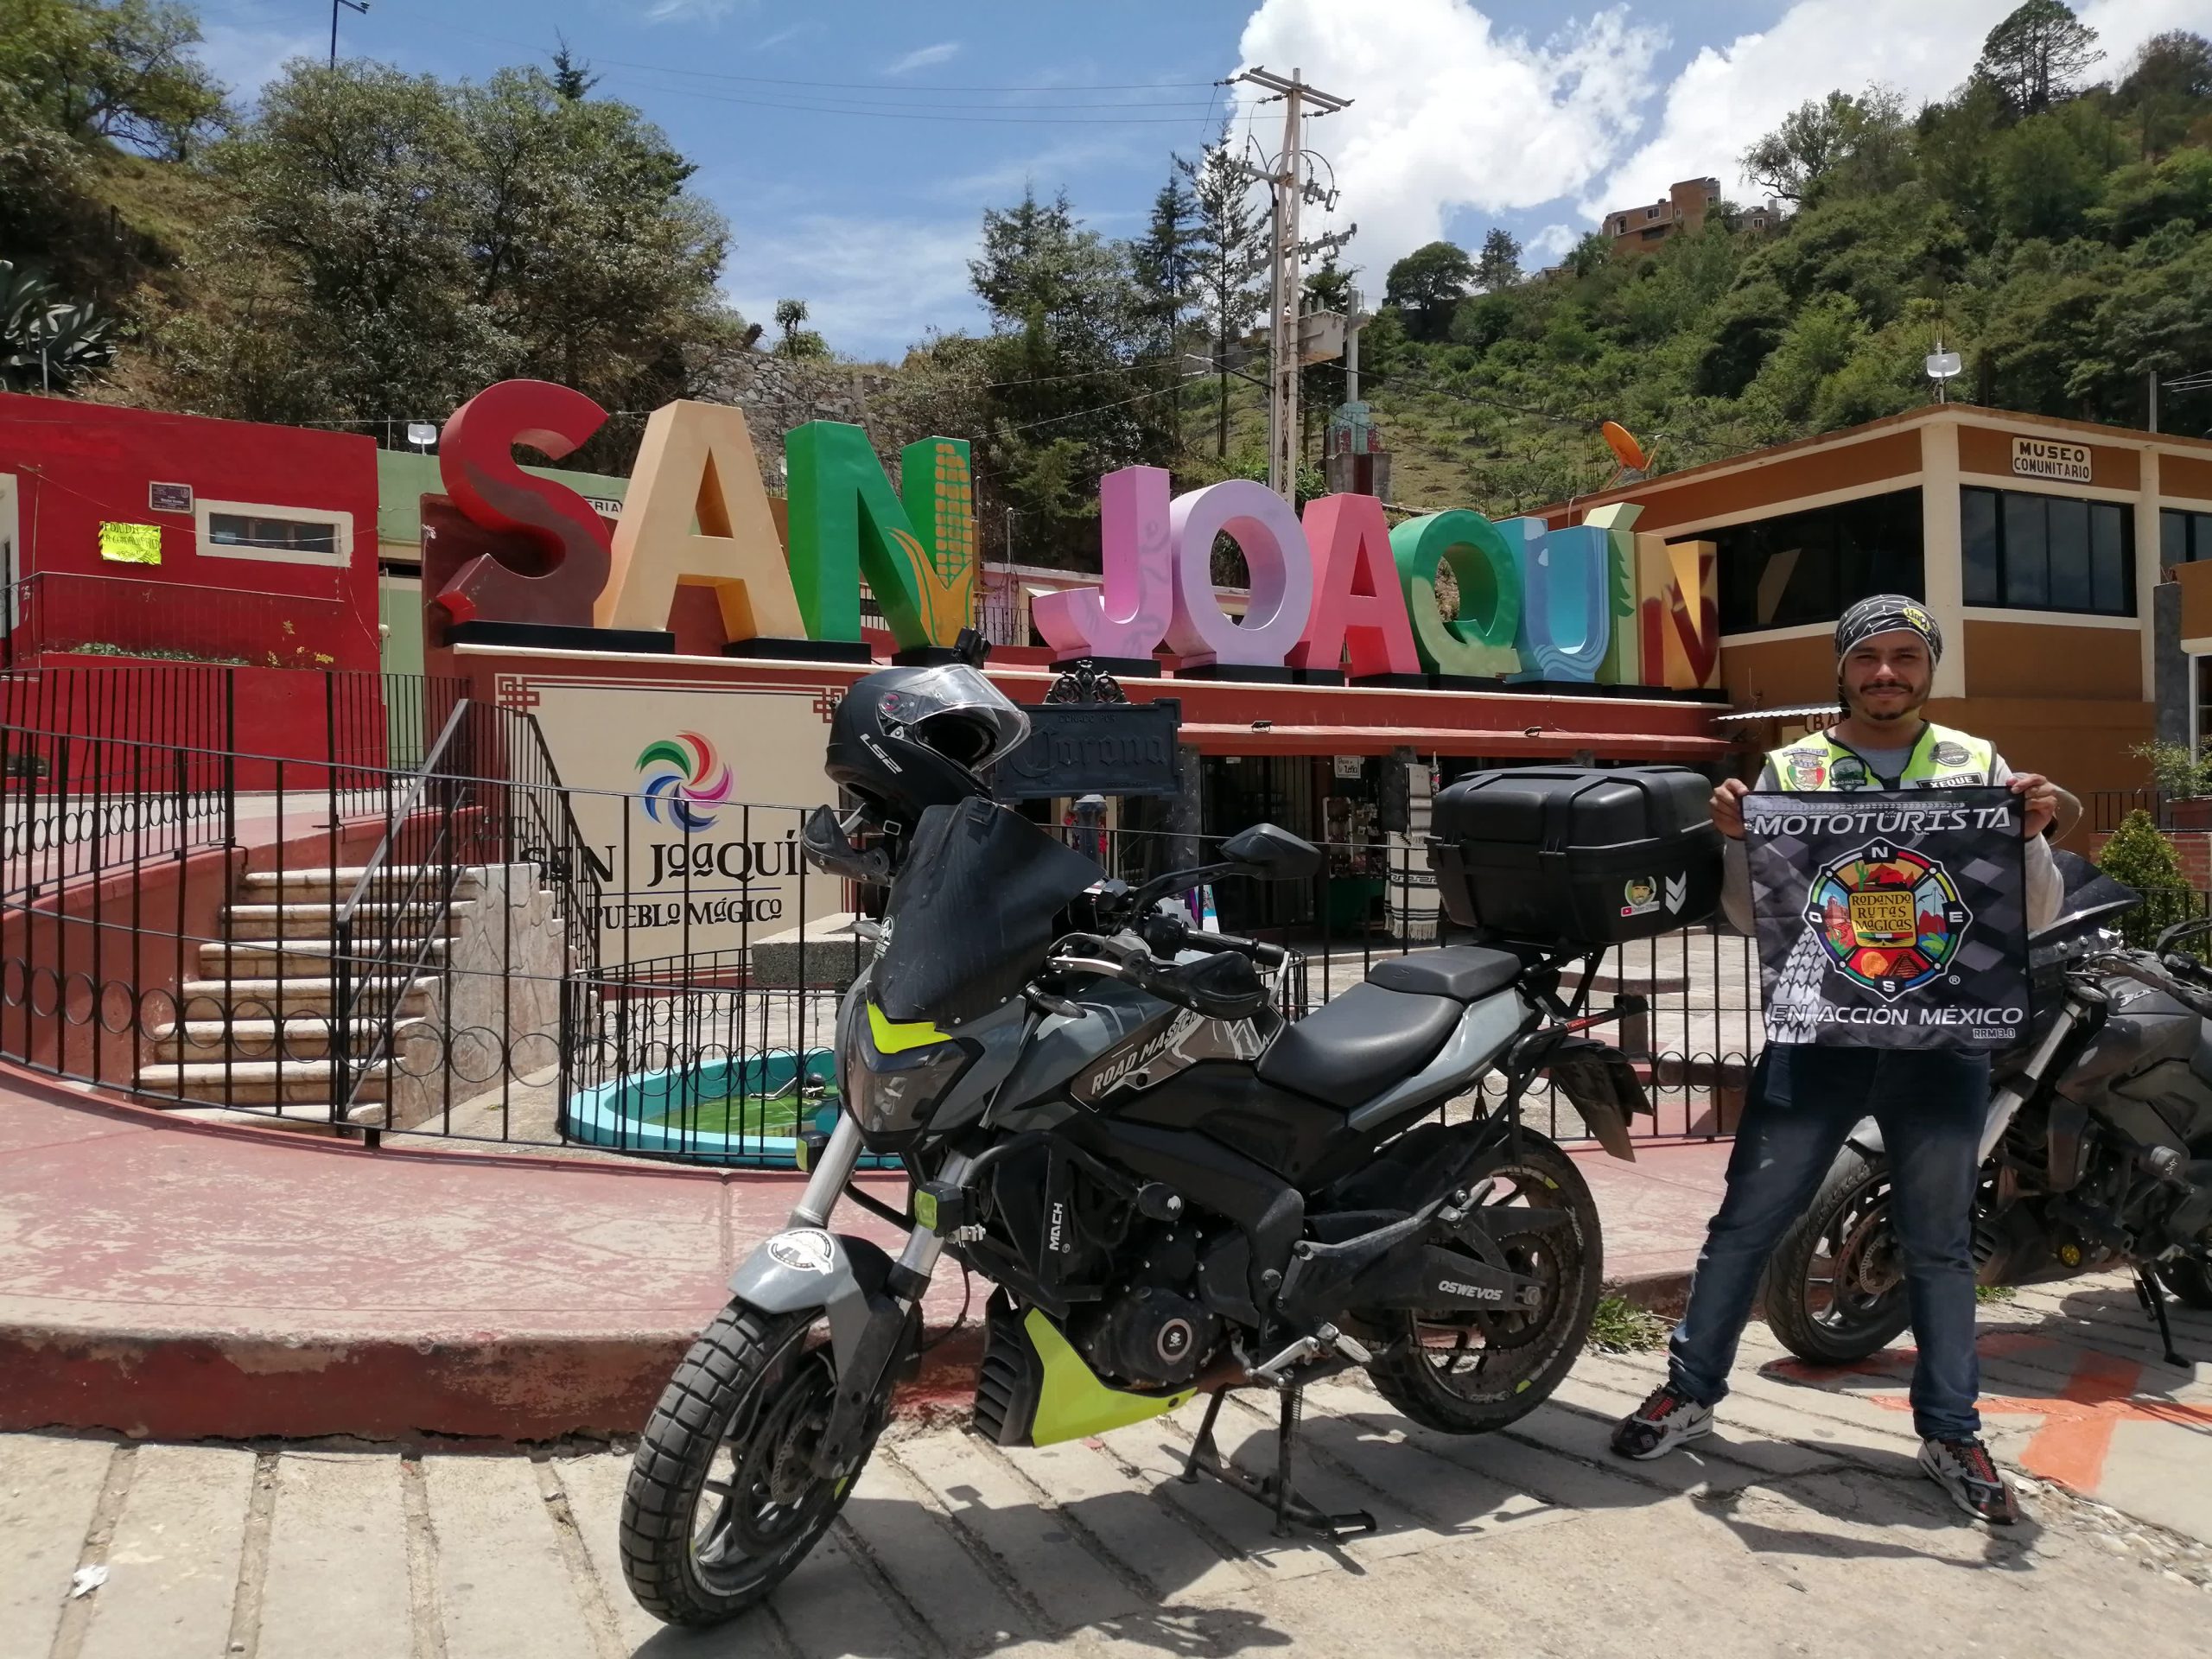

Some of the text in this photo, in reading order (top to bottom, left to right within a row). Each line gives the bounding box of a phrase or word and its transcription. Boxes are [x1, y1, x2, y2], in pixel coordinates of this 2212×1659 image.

[2019, 442, 2085, 462] MUSEO
[2014, 457, 2089, 479] COMUNITARIO
[436, 378, 974, 648] SAN
[588, 500, 619, 512] RIA
[1033, 465, 1718, 690] JOAQUÍN
[860, 733, 904, 774] LS2
[1009, 722, 1166, 785] Corona
[1929, 776, 1974, 788] XEQUE
[1754, 806, 2012, 836] MOTOTURISTA
[1872, 846, 1889, 858] N
[1948, 911, 1964, 923] E
[1882, 980, 1896, 993] S
[1770, 1004, 2024, 1026] EN ACCIÓN MÉXICO
[1090, 1051, 1139, 1096] ROAD
[1049, 1202, 1064, 1251] MACH
[1438, 1280, 1503, 1300] OSWEVOS
